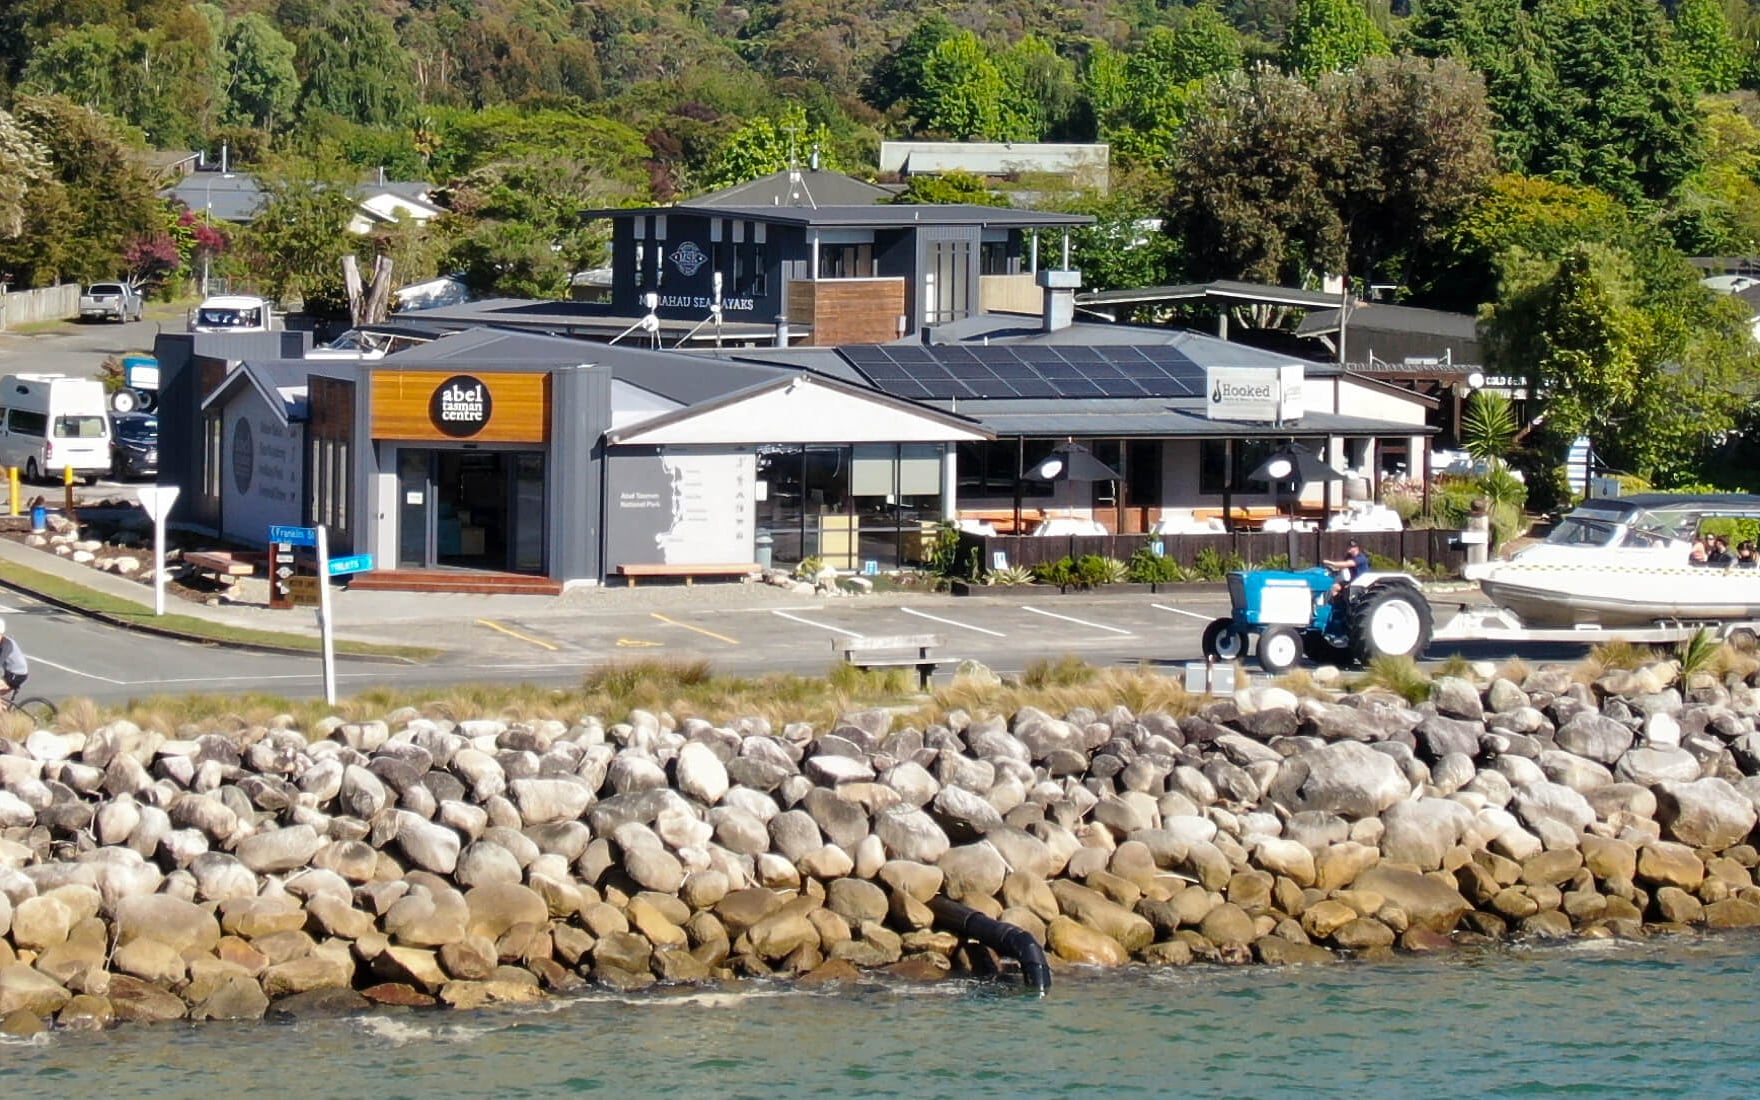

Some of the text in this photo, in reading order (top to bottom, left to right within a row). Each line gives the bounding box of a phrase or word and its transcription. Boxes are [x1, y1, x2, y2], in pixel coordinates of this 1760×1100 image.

[639, 294, 754, 310] MAHAU SEA AYAKS
[442, 384, 483, 402] abel
[1222, 384, 1270, 398] Hooked
[442, 402, 483, 413] tasman
[442, 412, 483, 421] centre
